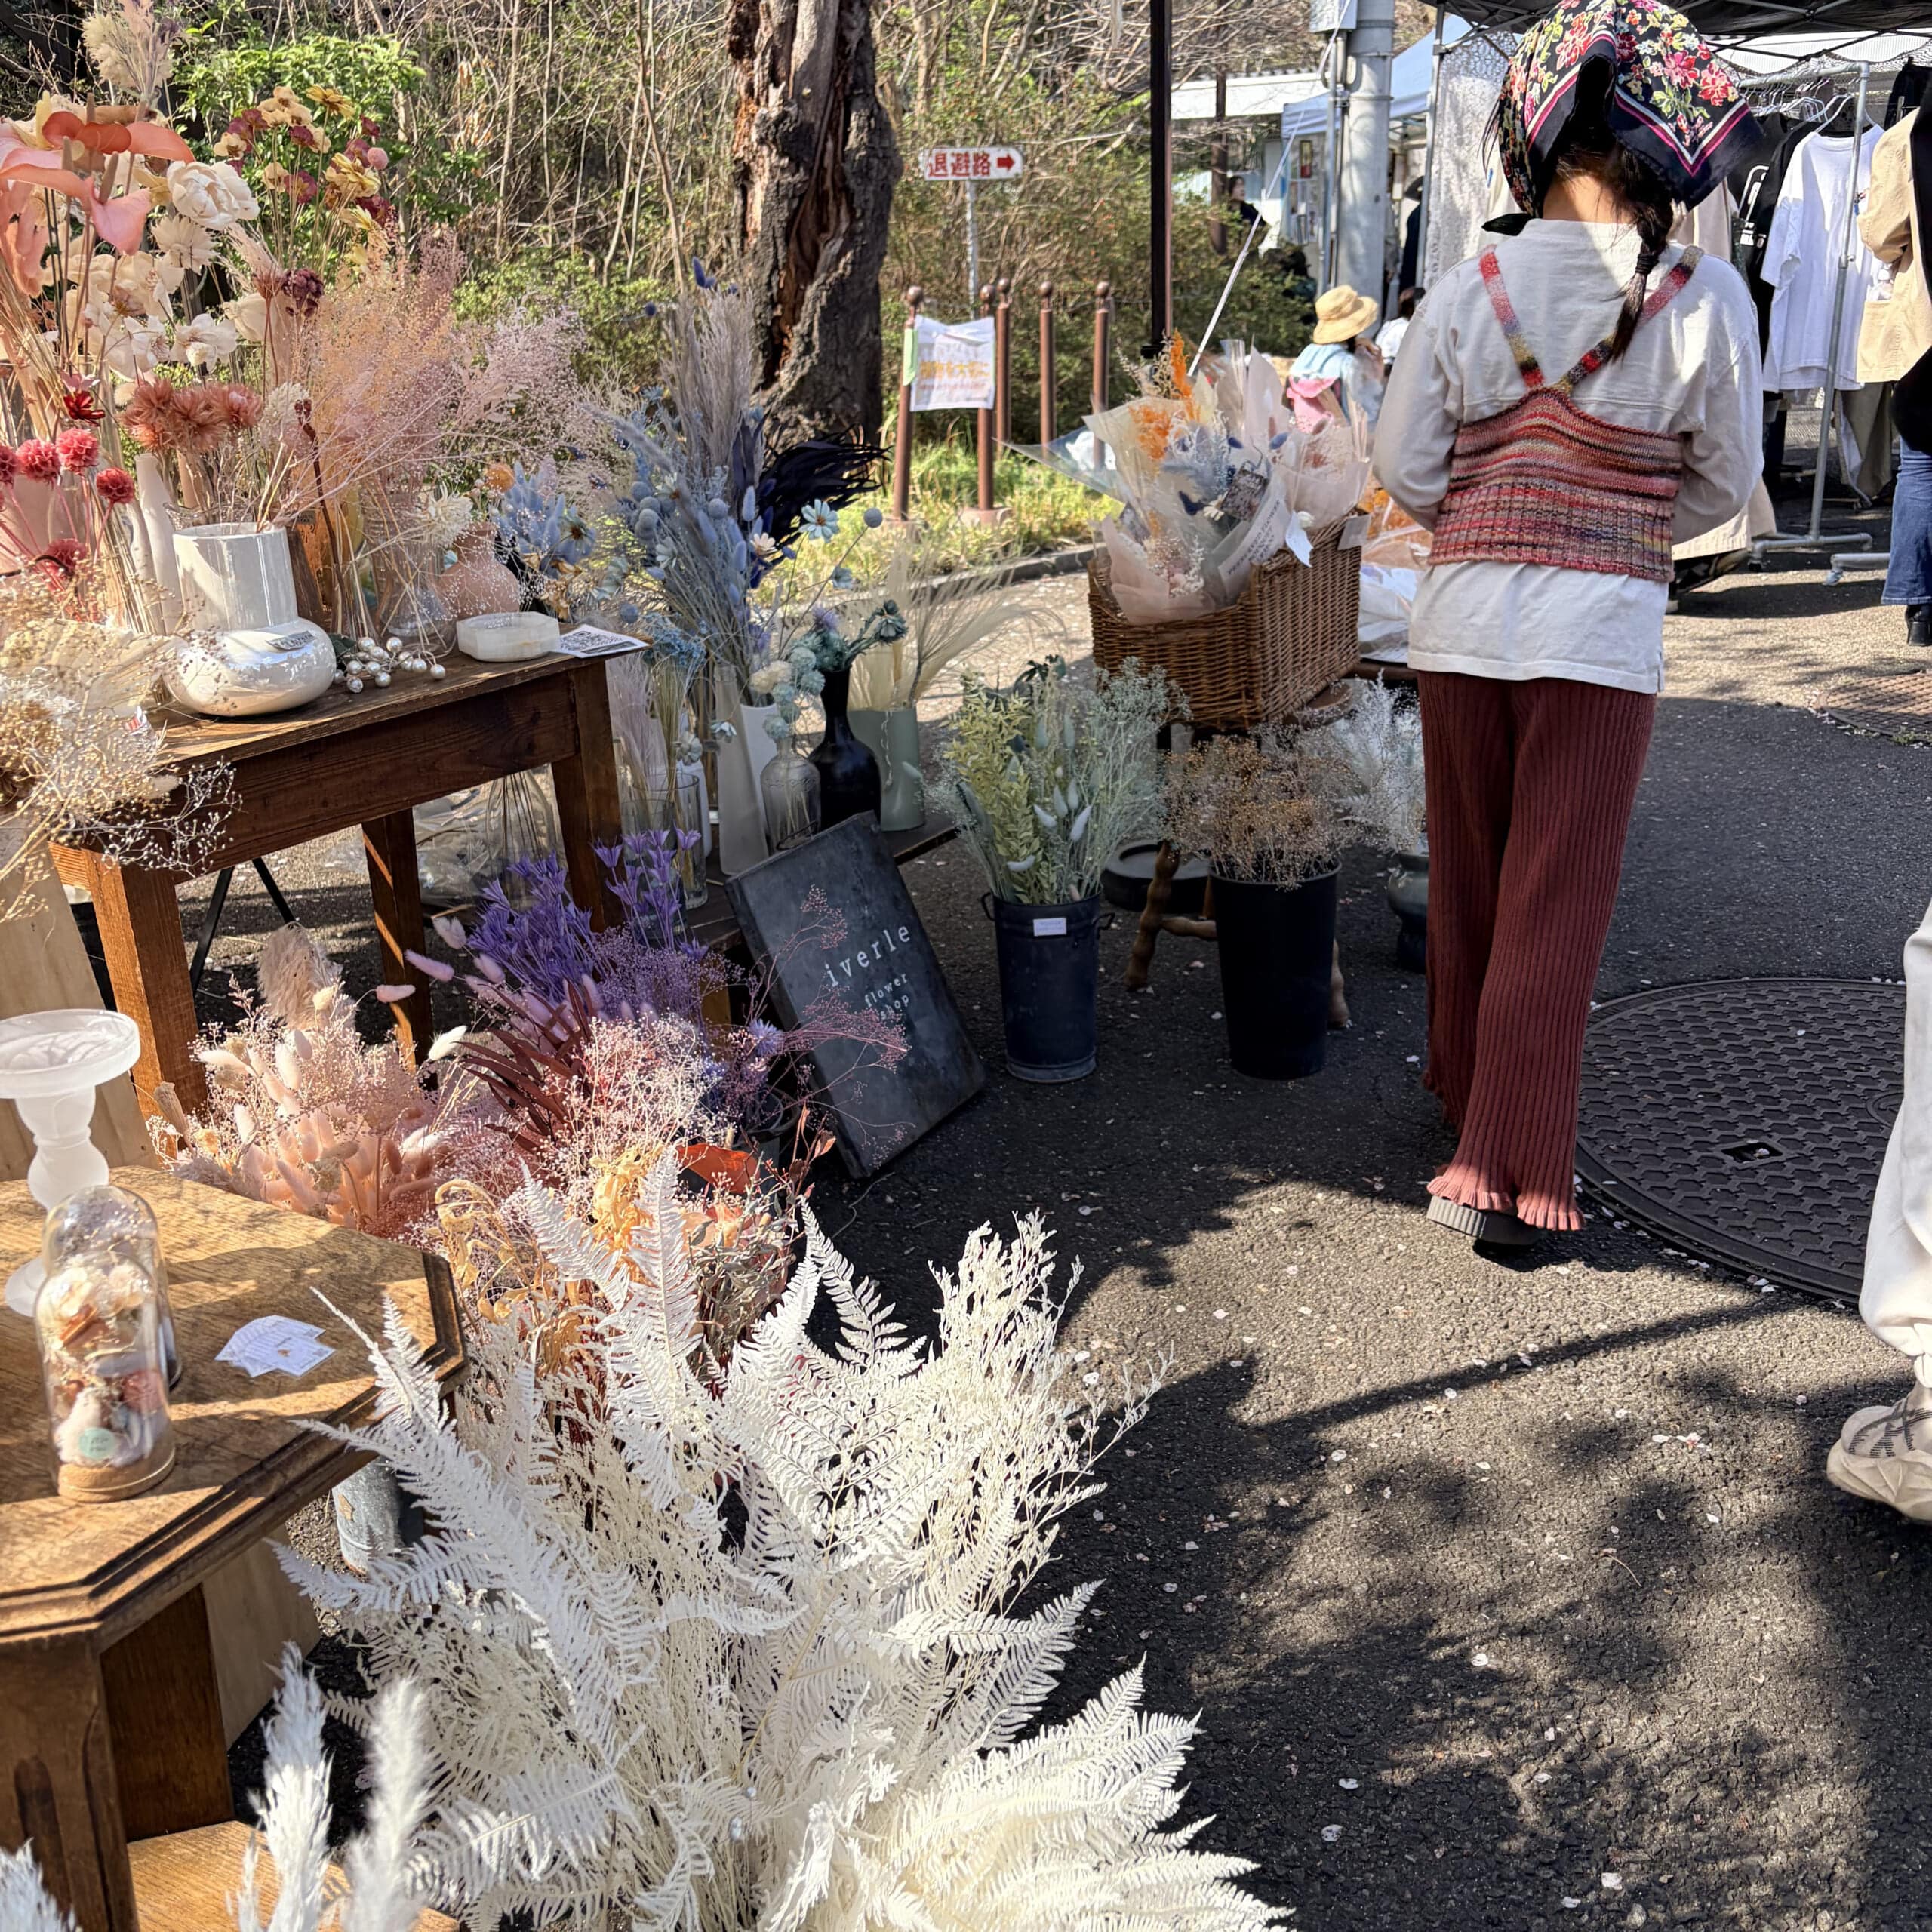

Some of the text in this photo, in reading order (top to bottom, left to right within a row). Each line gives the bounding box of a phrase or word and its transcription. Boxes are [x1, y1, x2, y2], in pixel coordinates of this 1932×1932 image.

[928, 152, 990, 177] 退避路
[1261, 499, 1280, 533] FLOWER
[825, 926, 910, 987] iverle
[864, 974, 907, 1008] flower
[880, 995, 909, 1020] shop
